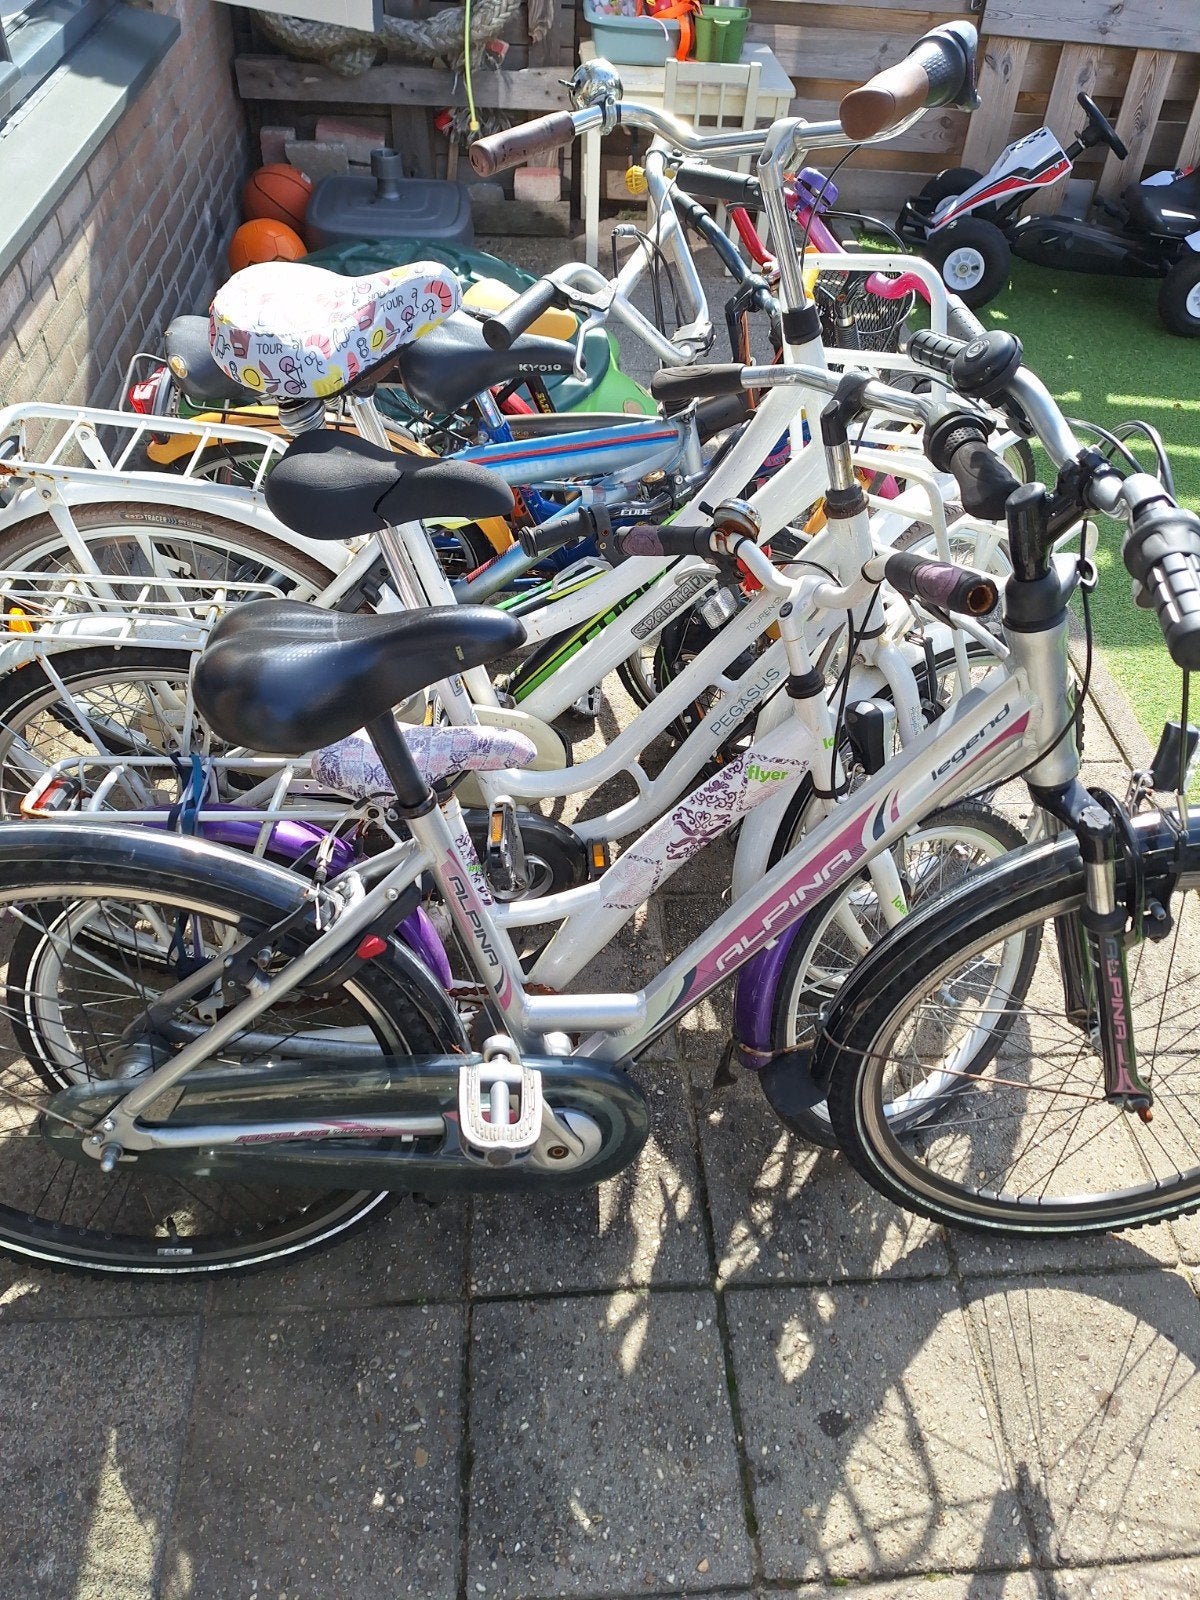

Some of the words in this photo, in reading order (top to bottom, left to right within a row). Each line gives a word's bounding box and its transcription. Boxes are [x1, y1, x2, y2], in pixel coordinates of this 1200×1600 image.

[381, 294, 404, 312] TOUR
[256, 342, 283, 355] TOUR
[518, 363, 562, 372] KYOSO
[144, 513, 167, 523] TRACER
[709, 667, 780, 736] PEGASUS
[931, 703, 1010, 781] legend
[747, 763, 789, 783] flyer
[448, 875, 499, 967] ALPINA
[716, 849, 852, 972] ALPINA
[1104, 937, 1128, 1041] ALPINA
